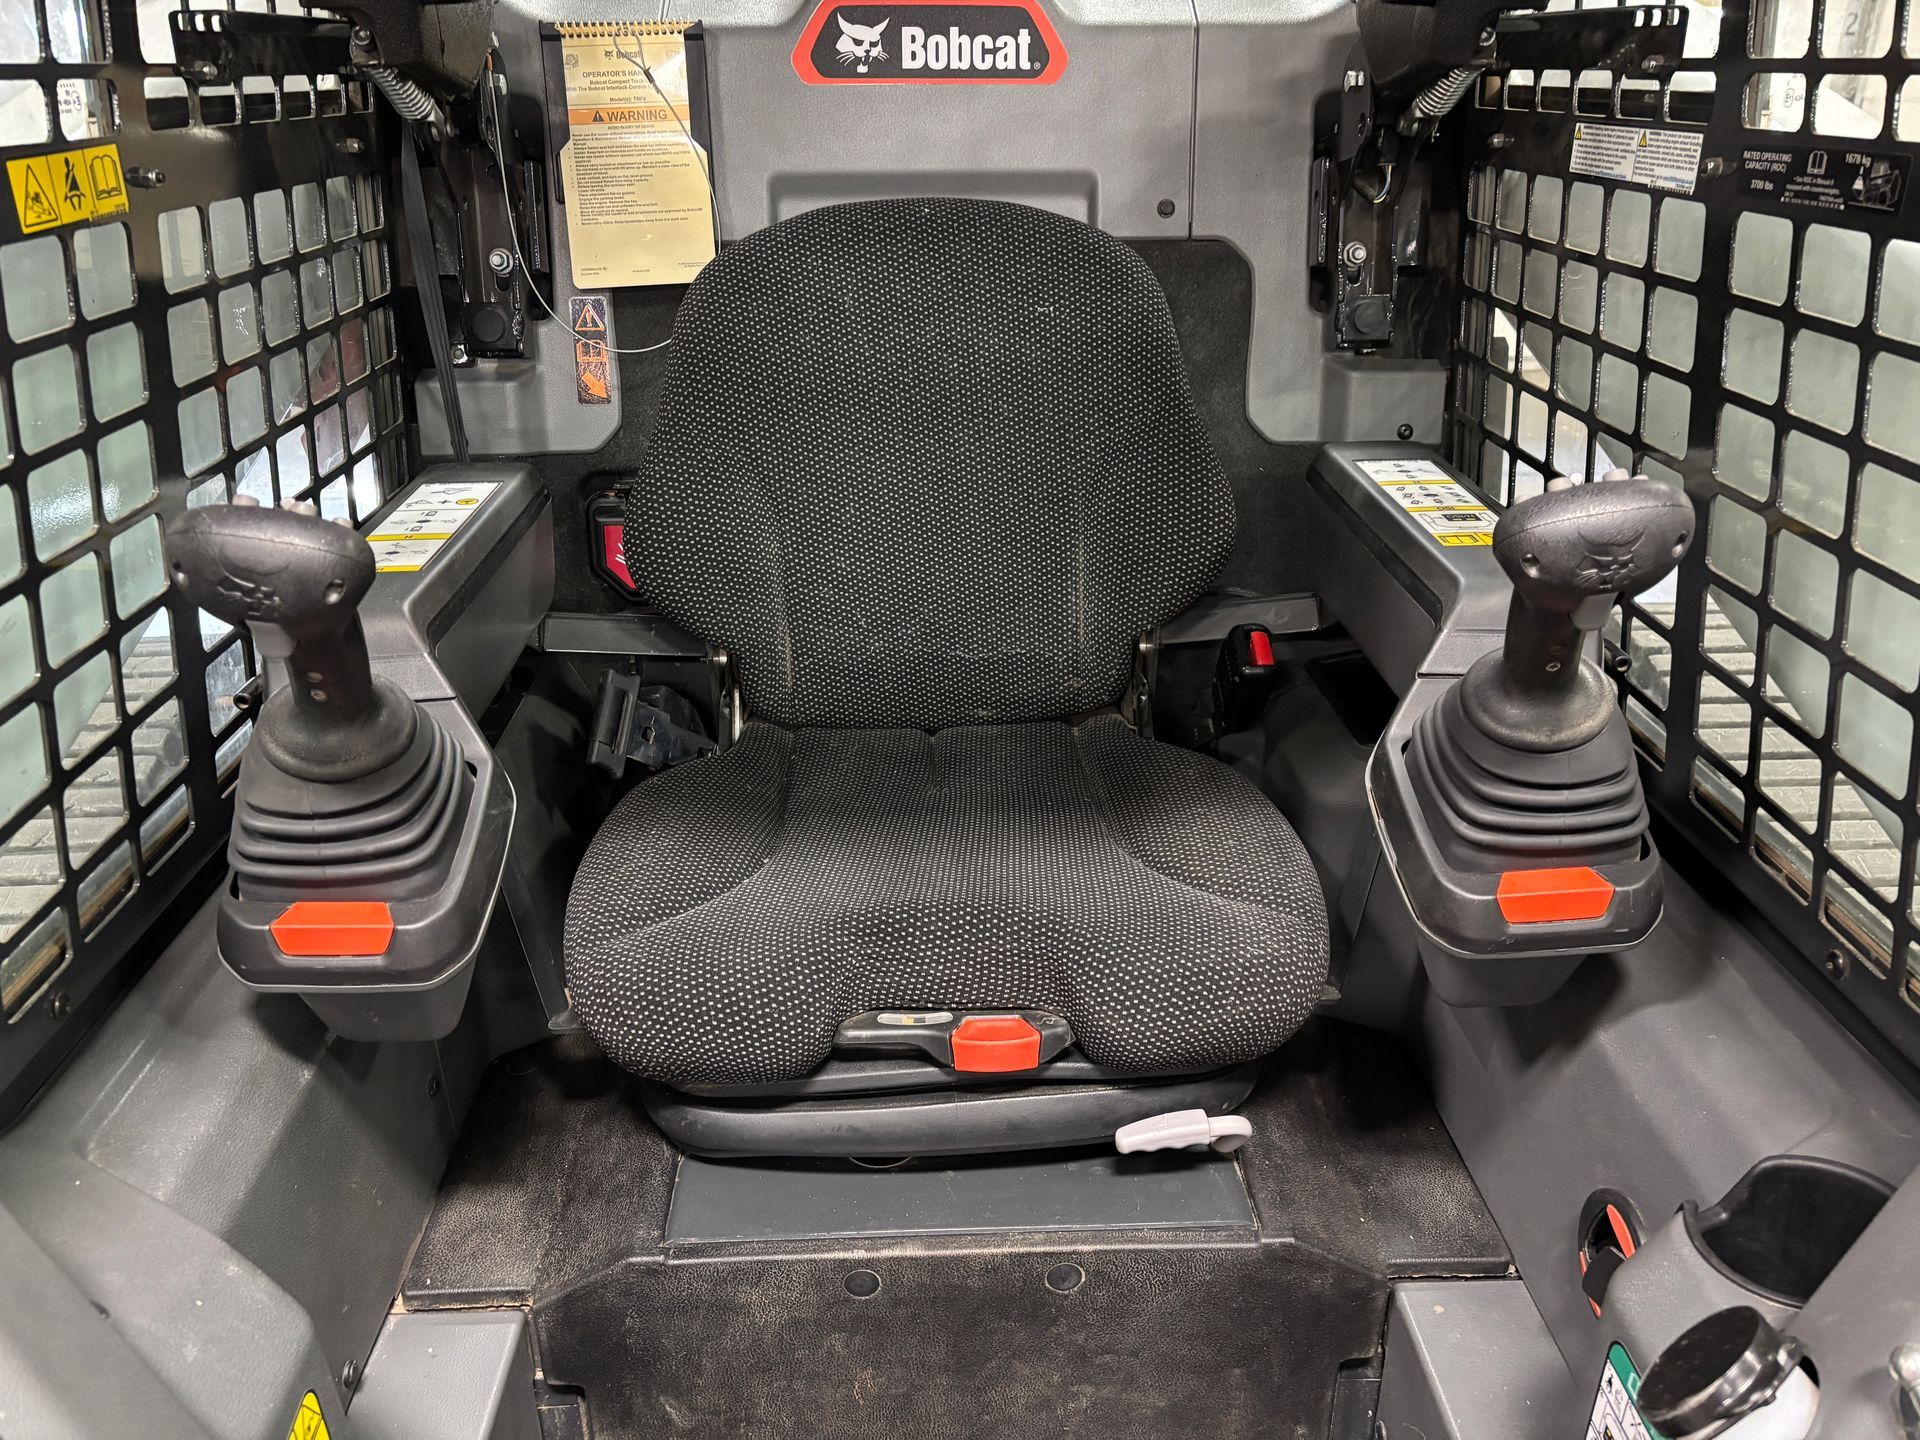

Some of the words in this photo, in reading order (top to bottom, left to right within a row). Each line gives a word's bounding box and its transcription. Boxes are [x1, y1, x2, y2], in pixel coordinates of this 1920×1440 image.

[902, 26, 1031, 70] Bobcat
[608, 110, 668, 122] WARNING
[1743, 151, 1760, 160] RATED
[1761, 152, 1792, 162] OPERATING
[1846, 153, 1861, 164] 1678
[1862, 154, 1872, 167] kg
[1745, 160, 1770, 171] CAPACITY
[1771, 162, 1787, 174] (ROC)
[1750, 179, 1764, 190] 3700
[1765, 180, 1774, 191] lbs
